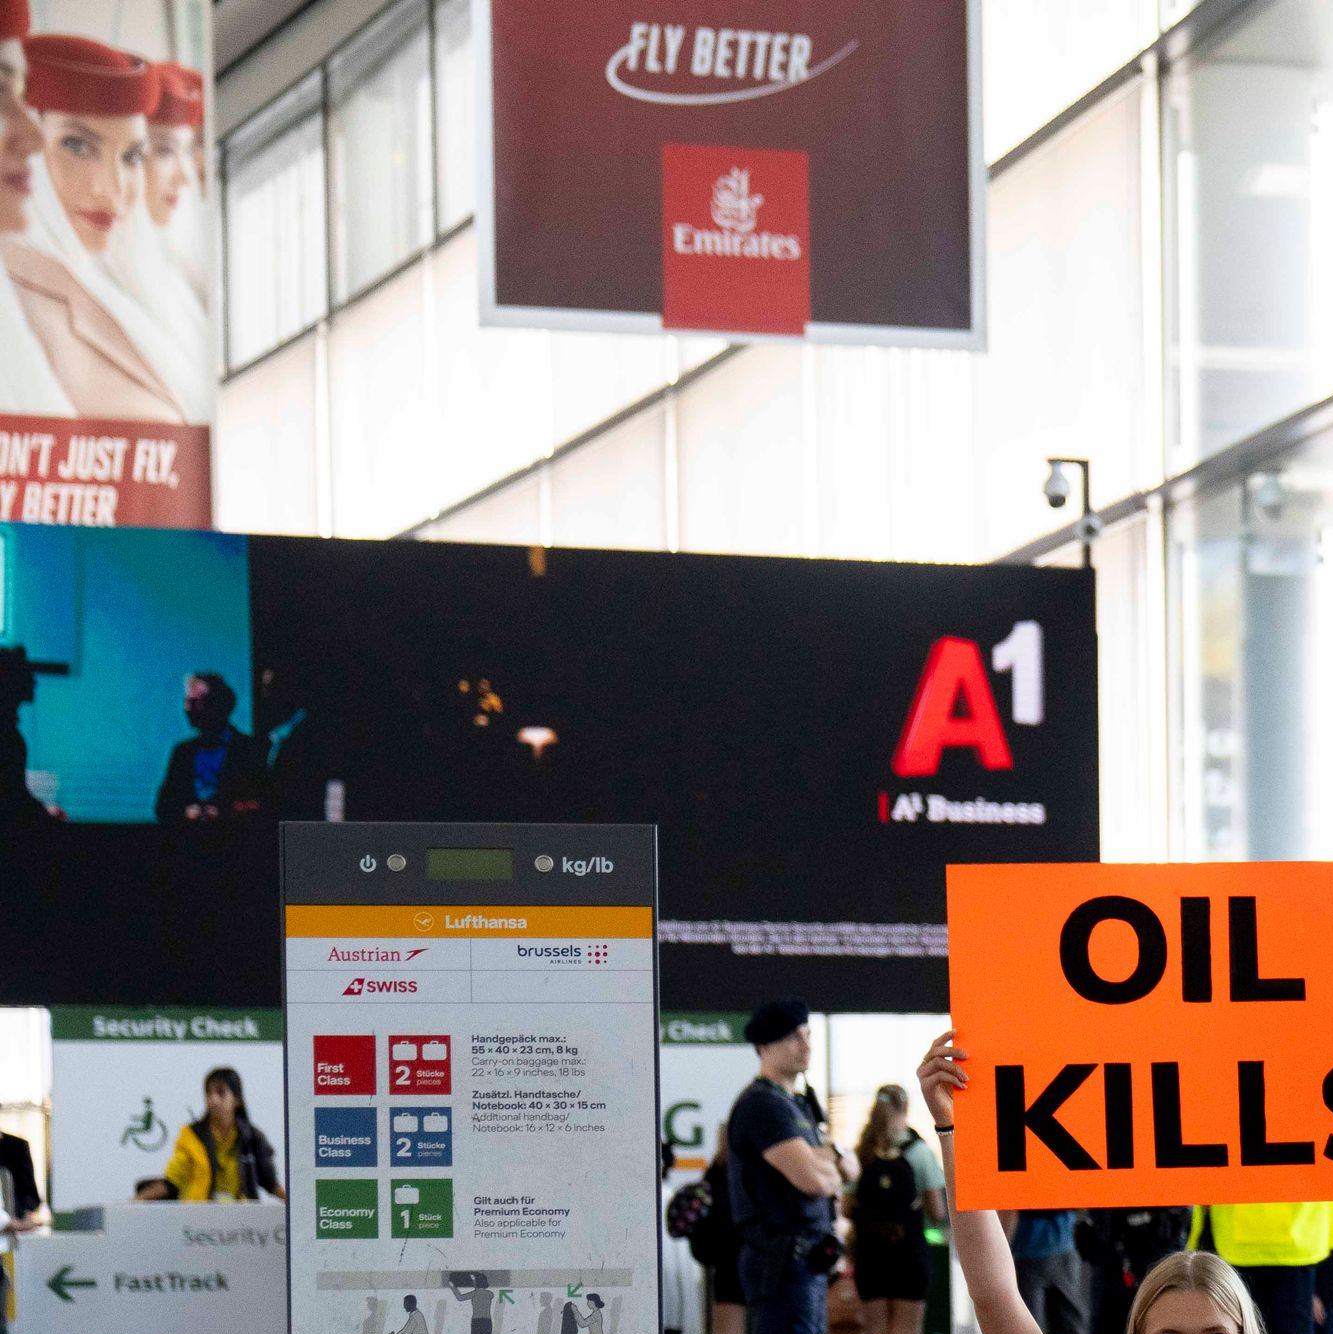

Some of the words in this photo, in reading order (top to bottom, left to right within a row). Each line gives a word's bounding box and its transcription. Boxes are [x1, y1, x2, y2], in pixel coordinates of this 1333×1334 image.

[628, 21, 687, 74] FLY
[690, 26, 813, 82] BETTER
[672, 222, 801, 261] Emirates
[58, 434, 130, 482] JUST
[132, 438, 180, 489] FLY,
[22, 481, 119, 526] BETTER
[891, 620, 1045, 777] A1
[926, 794, 1046, 825] Business
[562, 856, 614, 876] kg/lb
[445, 914, 528, 930] Lufthansa
[328, 947, 401, 962] Austrian
[517, 944, 582, 958] brussels
[1059, 895, 1306, 1005] OIL
[367, 980, 418, 993] SWISS
[93, 1014, 187, 1042] Security
[190, 1016, 260, 1040] Check
[667, 1019, 732, 1042] Check
[471, 1035, 537, 1045] Handgepäck
[471, 1046, 485, 1054] 55
[495, 1046, 510, 1054] 40
[520, 1046, 533, 1054] 23
[536, 1047, 554, 1056] cm,
[556, 1046, 564, 1054] 8
[566, 1046, 578, 1056] kg
[472, 1056, 514, 1067] Carry-on
[517, 1057, 559, 1067] baggage
[317, 1063, 344, 1073] First
[472, 1068, 484, 1076] 22
[495, 1068, 504, 1076] 16
[514, 1068, 520, 1076] 9
[523, 1068, 556, 1077] inches,
[559, 1068, 569, 1076] 18
[571, 1068, 586, 1076] lbs
[318, 1075, 350, 1086] Class
[396, 1066, 411, 1085] 2
[416, 1070, 444, 1078] Stücke
[472, 1090, 512, 1098] Zusätzl.
[515, 1090, 581, 1099] Handtasche/
[472, 1102, 526, 1110] Notebook:
[528, 1102, 543, 1110] 40
[553, 1102, 567, 1110] 30
[577, 1102, 588, 1110] 15
[590, 1102, 606, 1110] cm
[472, 1113, 520, 1121] Additional
[523, 1113, 570, 1123] handbag/
[472, 1124, 523, 1132] Notebook:
[526, 1124, 536, 1132] 16
[546, 1124, 555, 1132] 12
[565, 1124, 572, 1132] 6
[574, 1124, 605, 1132] inches
[319, 1135, 371, 1145] Business
[319, 1147, 351, 1157] Class
[397, 1139, 412, 1157] 2
[418, 1141, 446, 1149] Stücke
[474, 1196, 491, 1205] Gilt
[493, 1196, 519, 1205] auch
[521, 1196, 535, 1205] für
[320, 1207, 375, 1219] Economy
[474, 1207, 520, 1216] Premium
[522, 1207, 570, 1218] Economy
[320, 1219, 353, 1229] Class
[400, 1210, 410, 1229] 1
[419, 1213, 442, 1221] Stück
[474, 1218, 495, 1228] Also
[497, 1218, 546, 1229] applicable
[548, 1218, 561, 1227] for
[183, 1225, 268, 1251] Security
[474, 1230, 519, 1238] Premium
[520, 1230, 566, 1240] Economy
